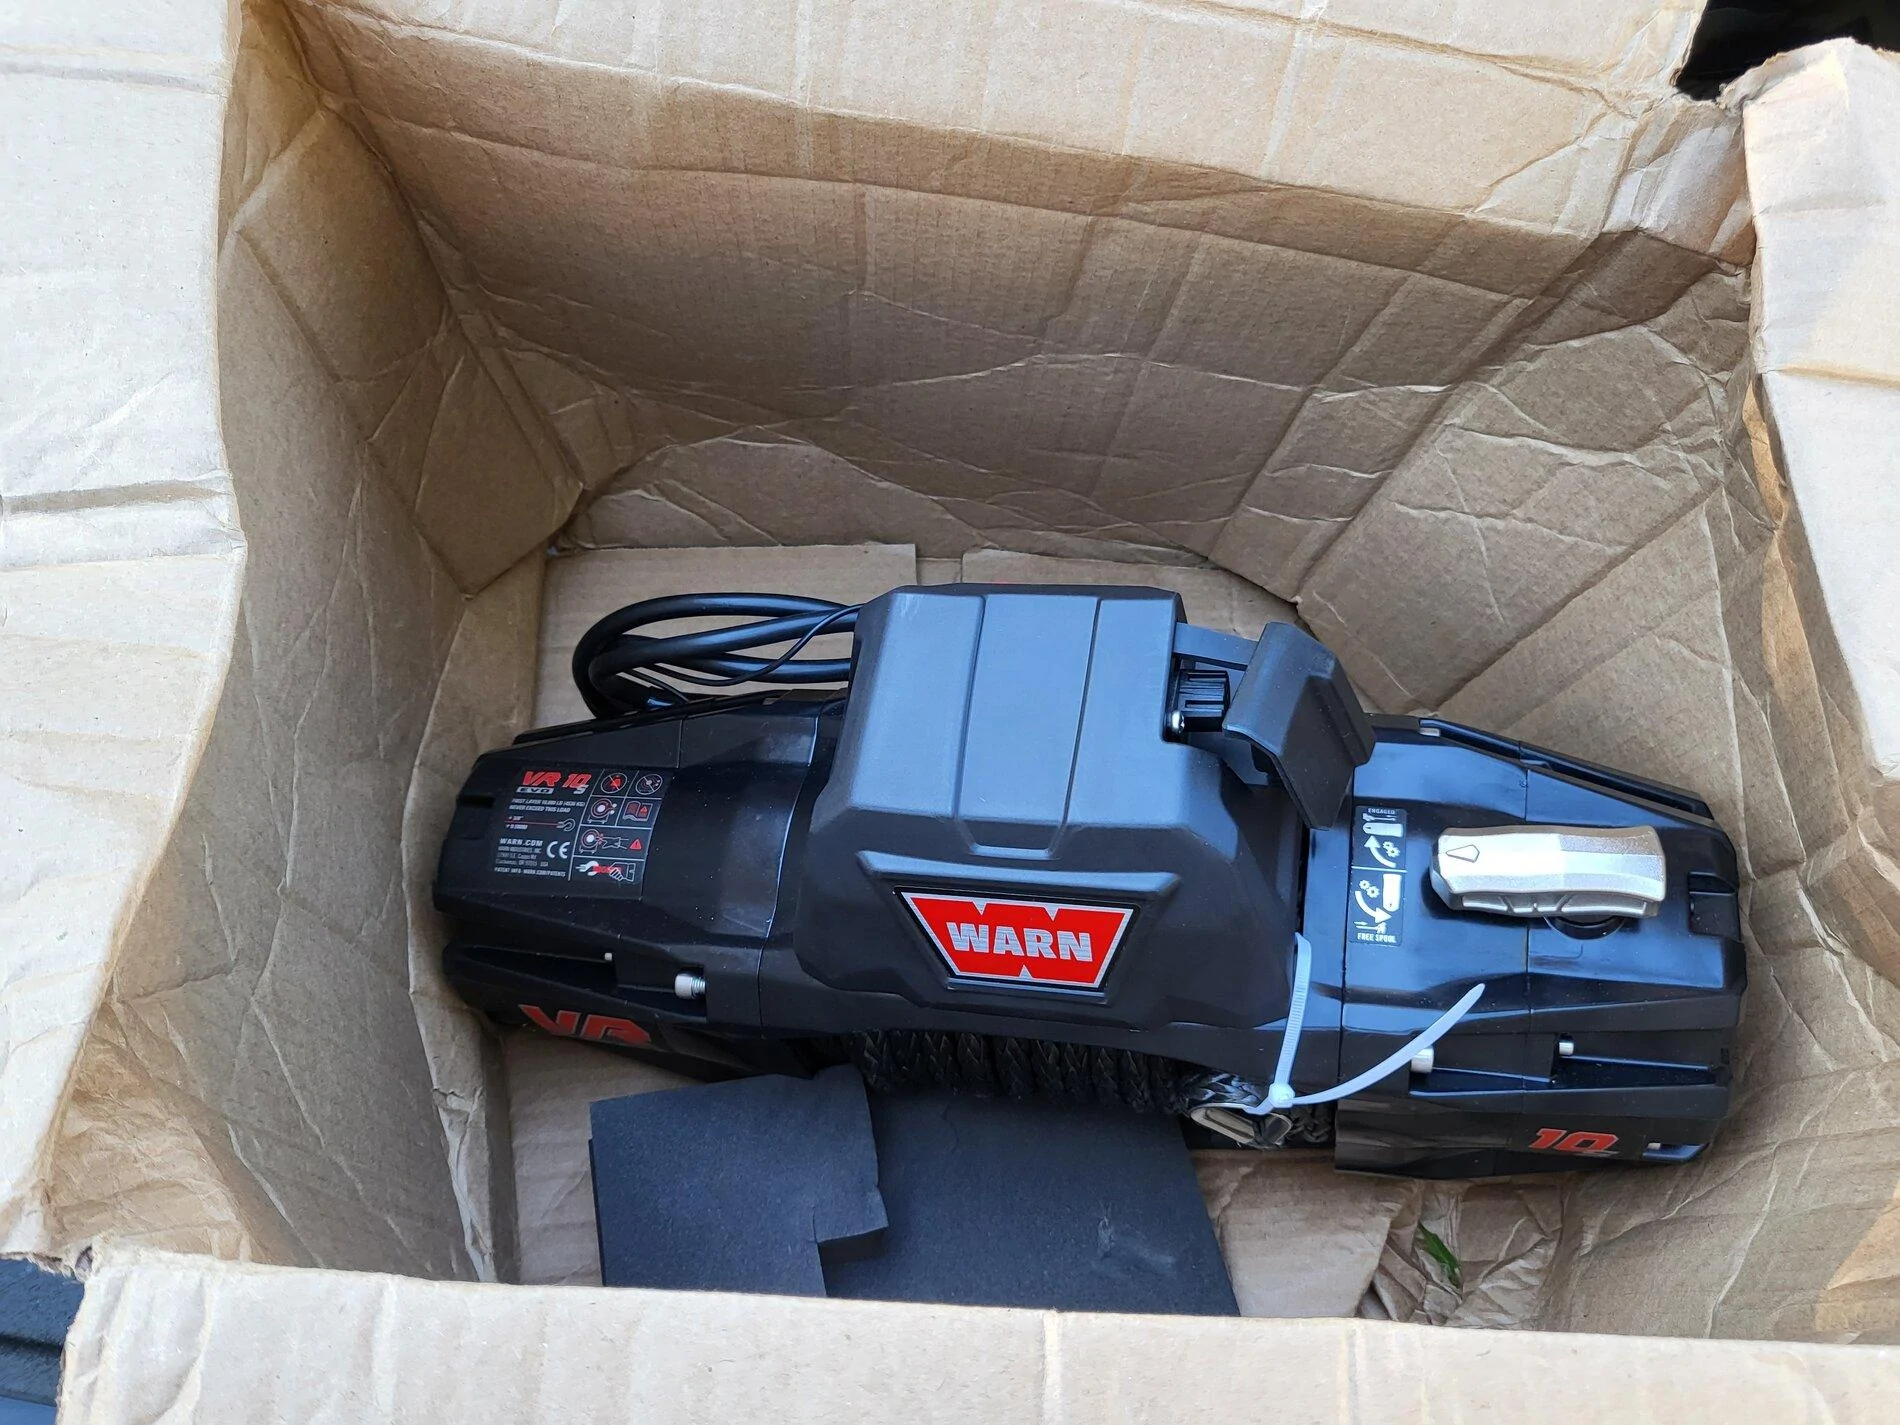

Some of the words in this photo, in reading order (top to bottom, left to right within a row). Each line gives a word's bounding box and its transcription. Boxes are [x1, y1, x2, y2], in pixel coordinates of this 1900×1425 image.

[523, 771, 561, 787] VR
[516, 786, 555, 794] EVO
[1367, 807, 1396, 815] ENGAGED
[500, 838, 544, 847] WARN.COM
[946, 921, 1093, 962] WARN
[1357, 932, 1374, 942] FREE
[1375, 934, 1396, 943] SPOOL
[1528, 1128, 1619, 1152] 10
